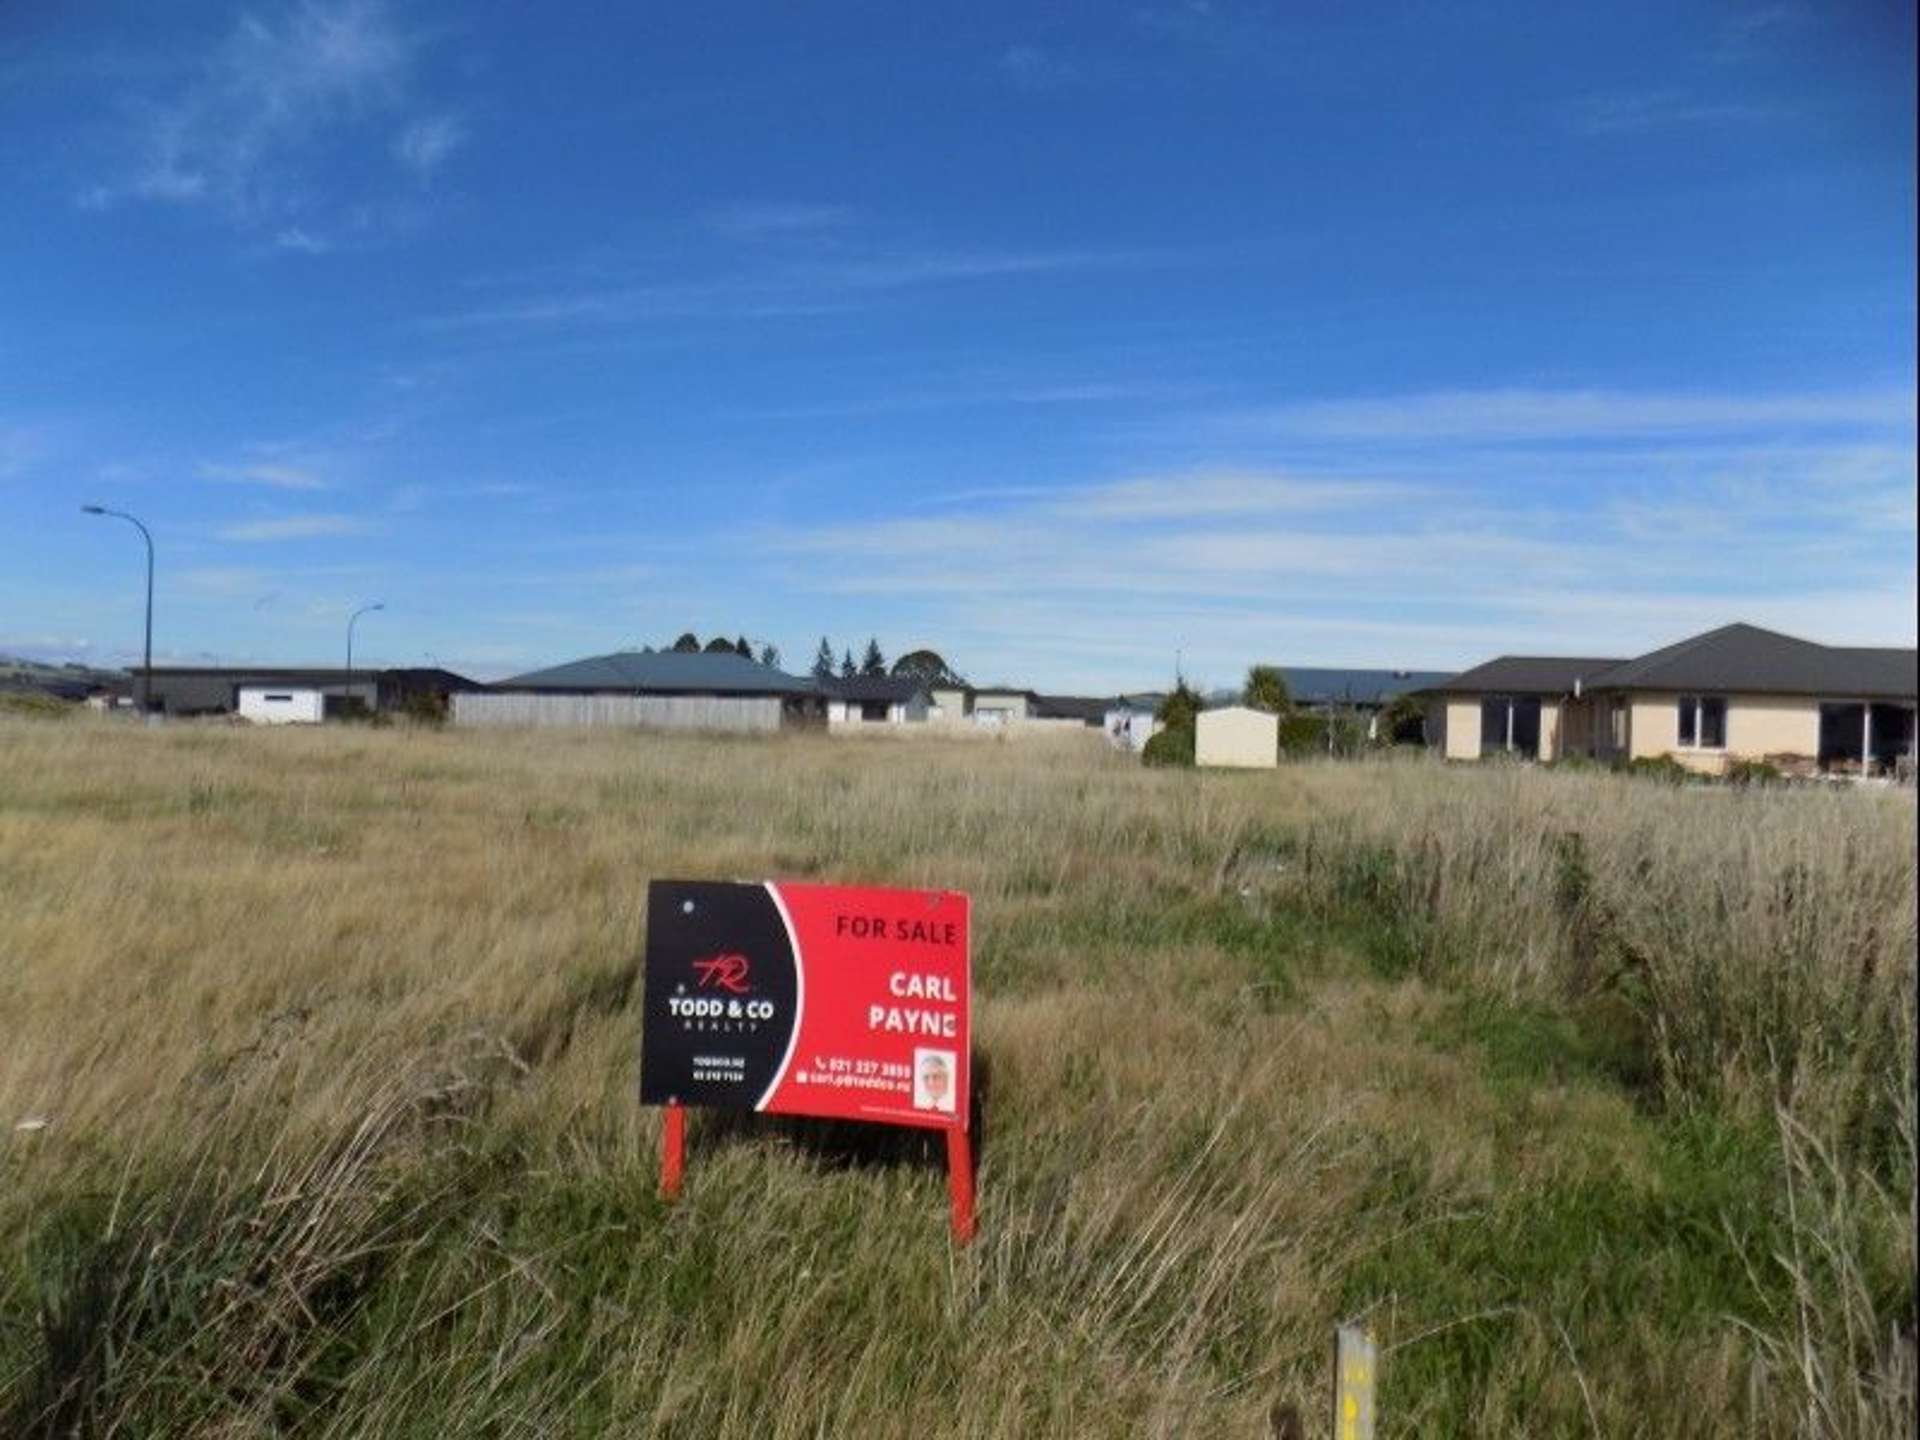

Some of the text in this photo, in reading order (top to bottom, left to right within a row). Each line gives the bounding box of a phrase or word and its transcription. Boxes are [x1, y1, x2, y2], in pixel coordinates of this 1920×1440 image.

[837, 916, 956, 945] FOR SALE
[889, 971, 957, 1002] CARL
[669, 998, 775, 1020] TODD & CO
[868, 1005, 957, 1038] PAYNE
